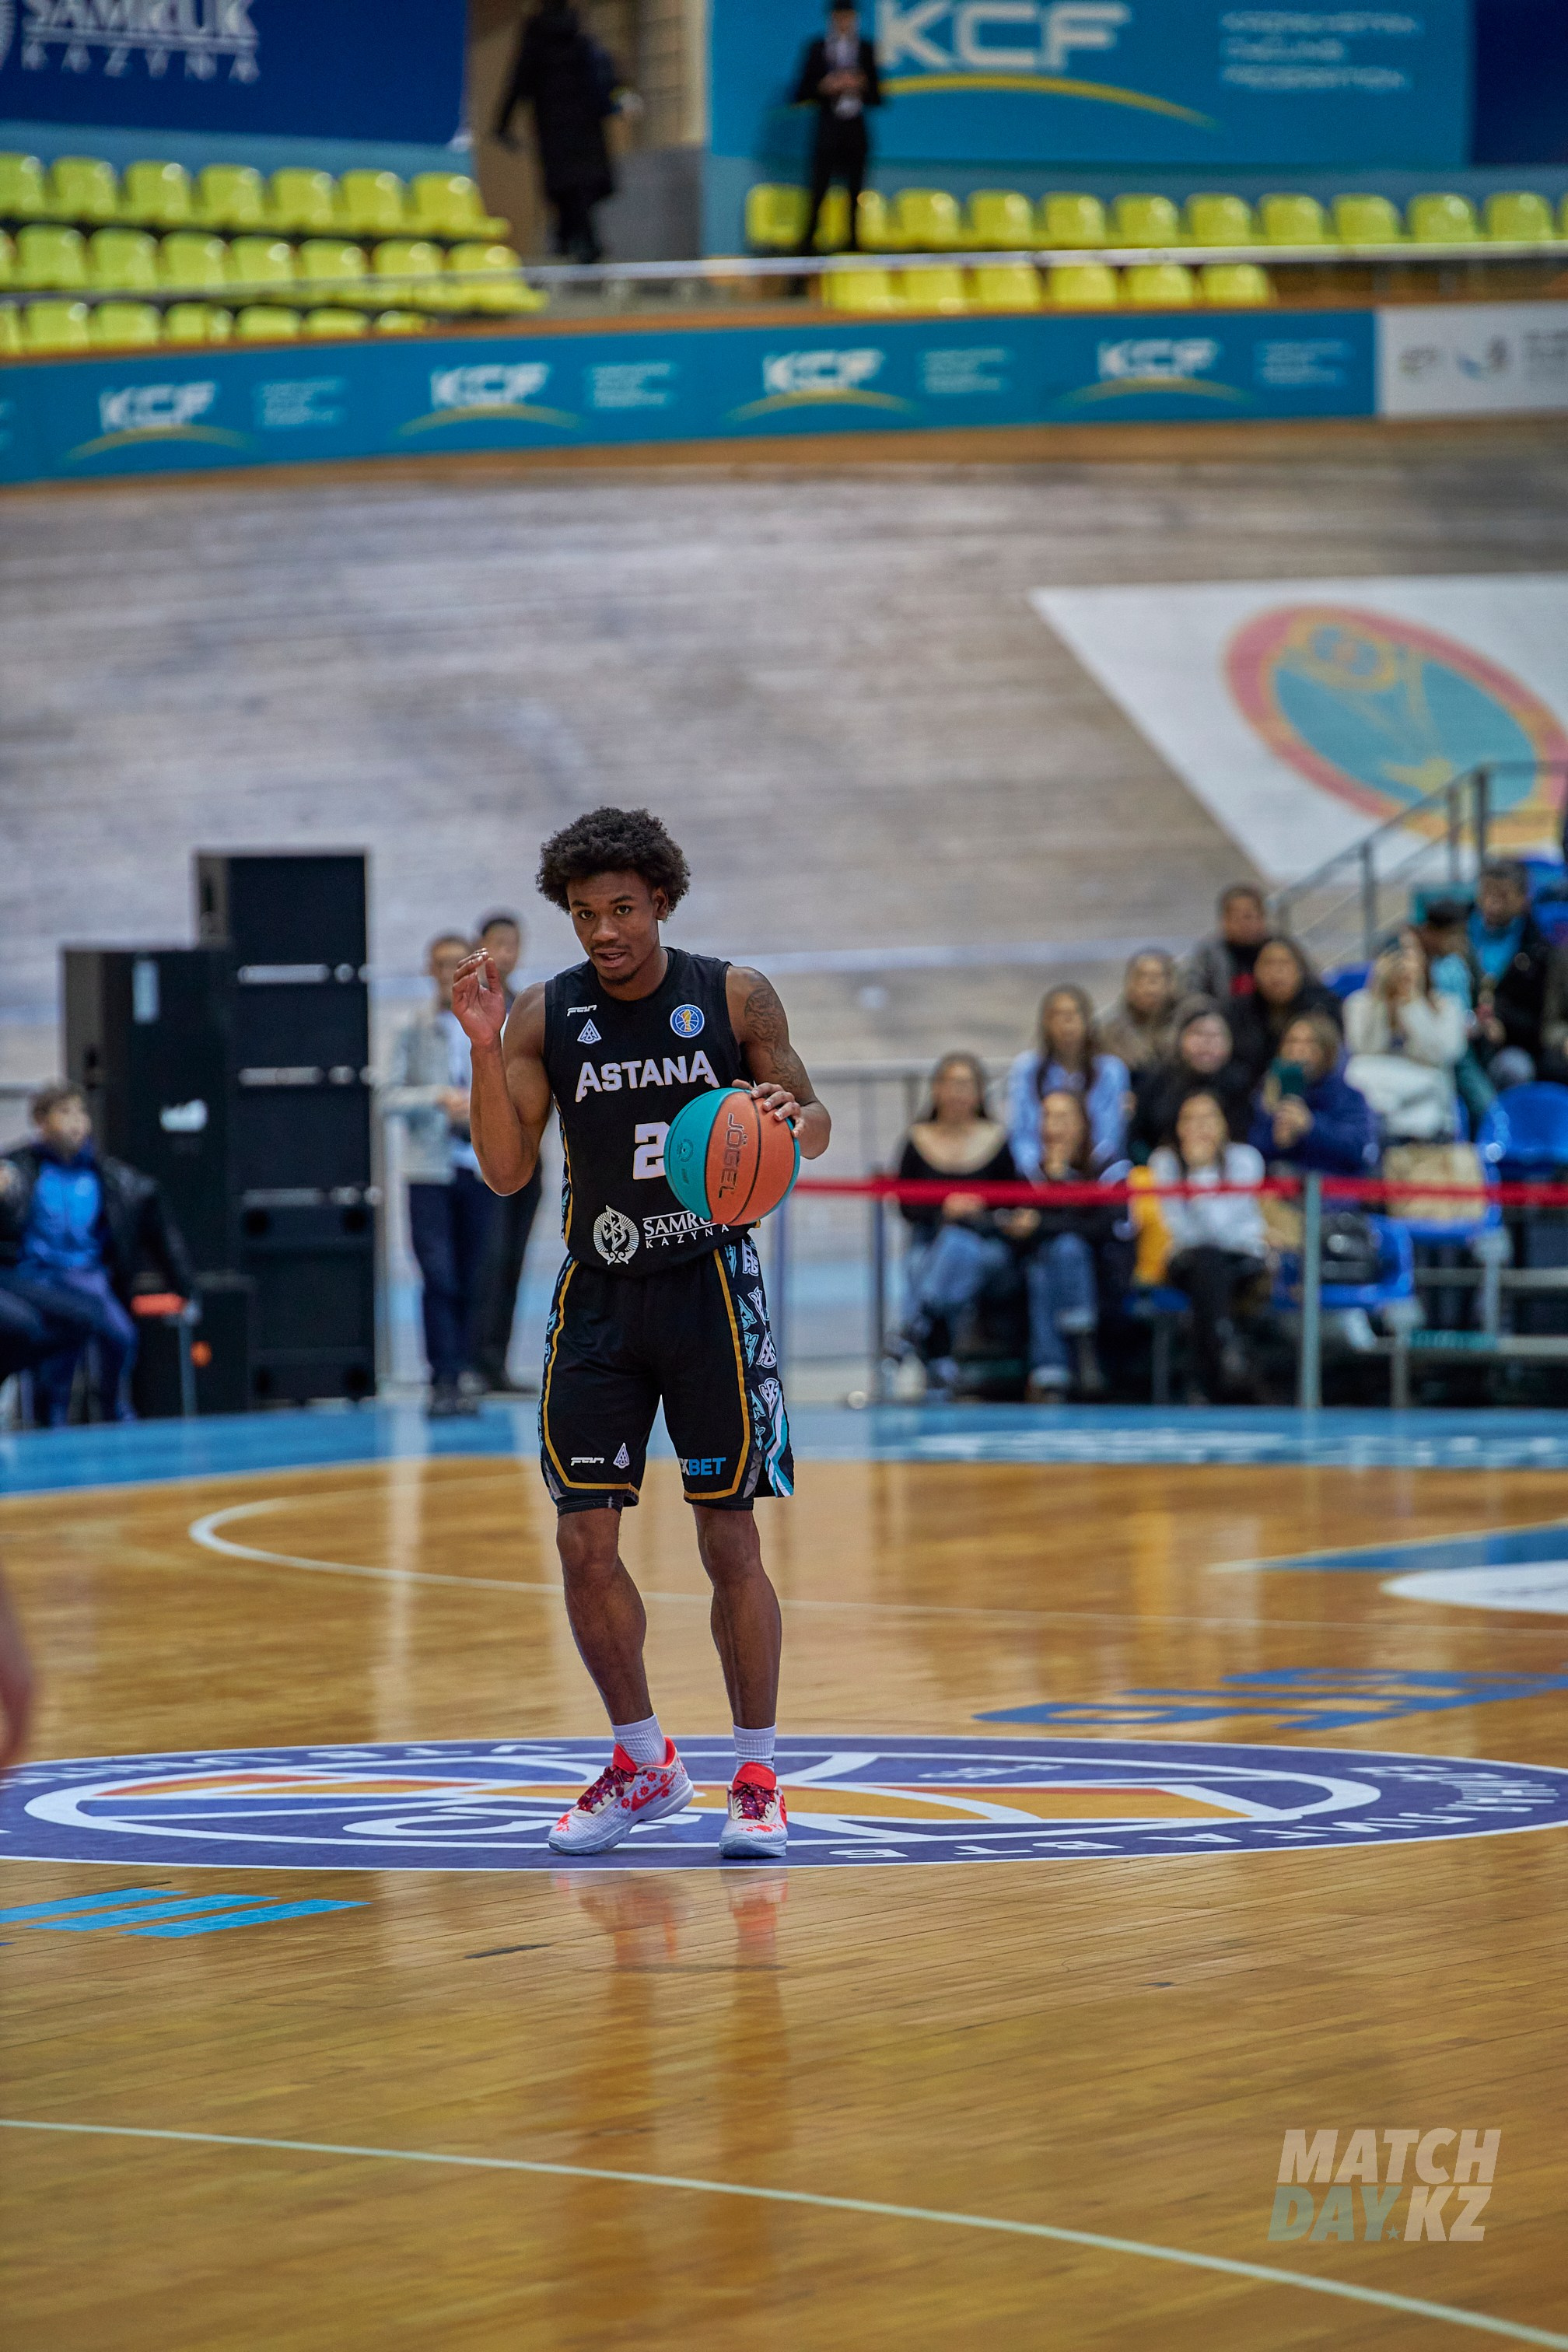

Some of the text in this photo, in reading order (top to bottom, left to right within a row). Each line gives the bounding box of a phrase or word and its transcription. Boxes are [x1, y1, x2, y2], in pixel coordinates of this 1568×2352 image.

[876, 0, 1129, 69] KCF
[576, 1051, 719, 1102] ASTANA
[643, 1213, 711, 1237] SAMR
[646, 1223, 730, 1249] KAZYNA
[677, 1457, 726, 1476] XBET
[1136, 1812, 1478, 1843] ЛИГА
[828, 1840, 1125, 1859] ВТБ
